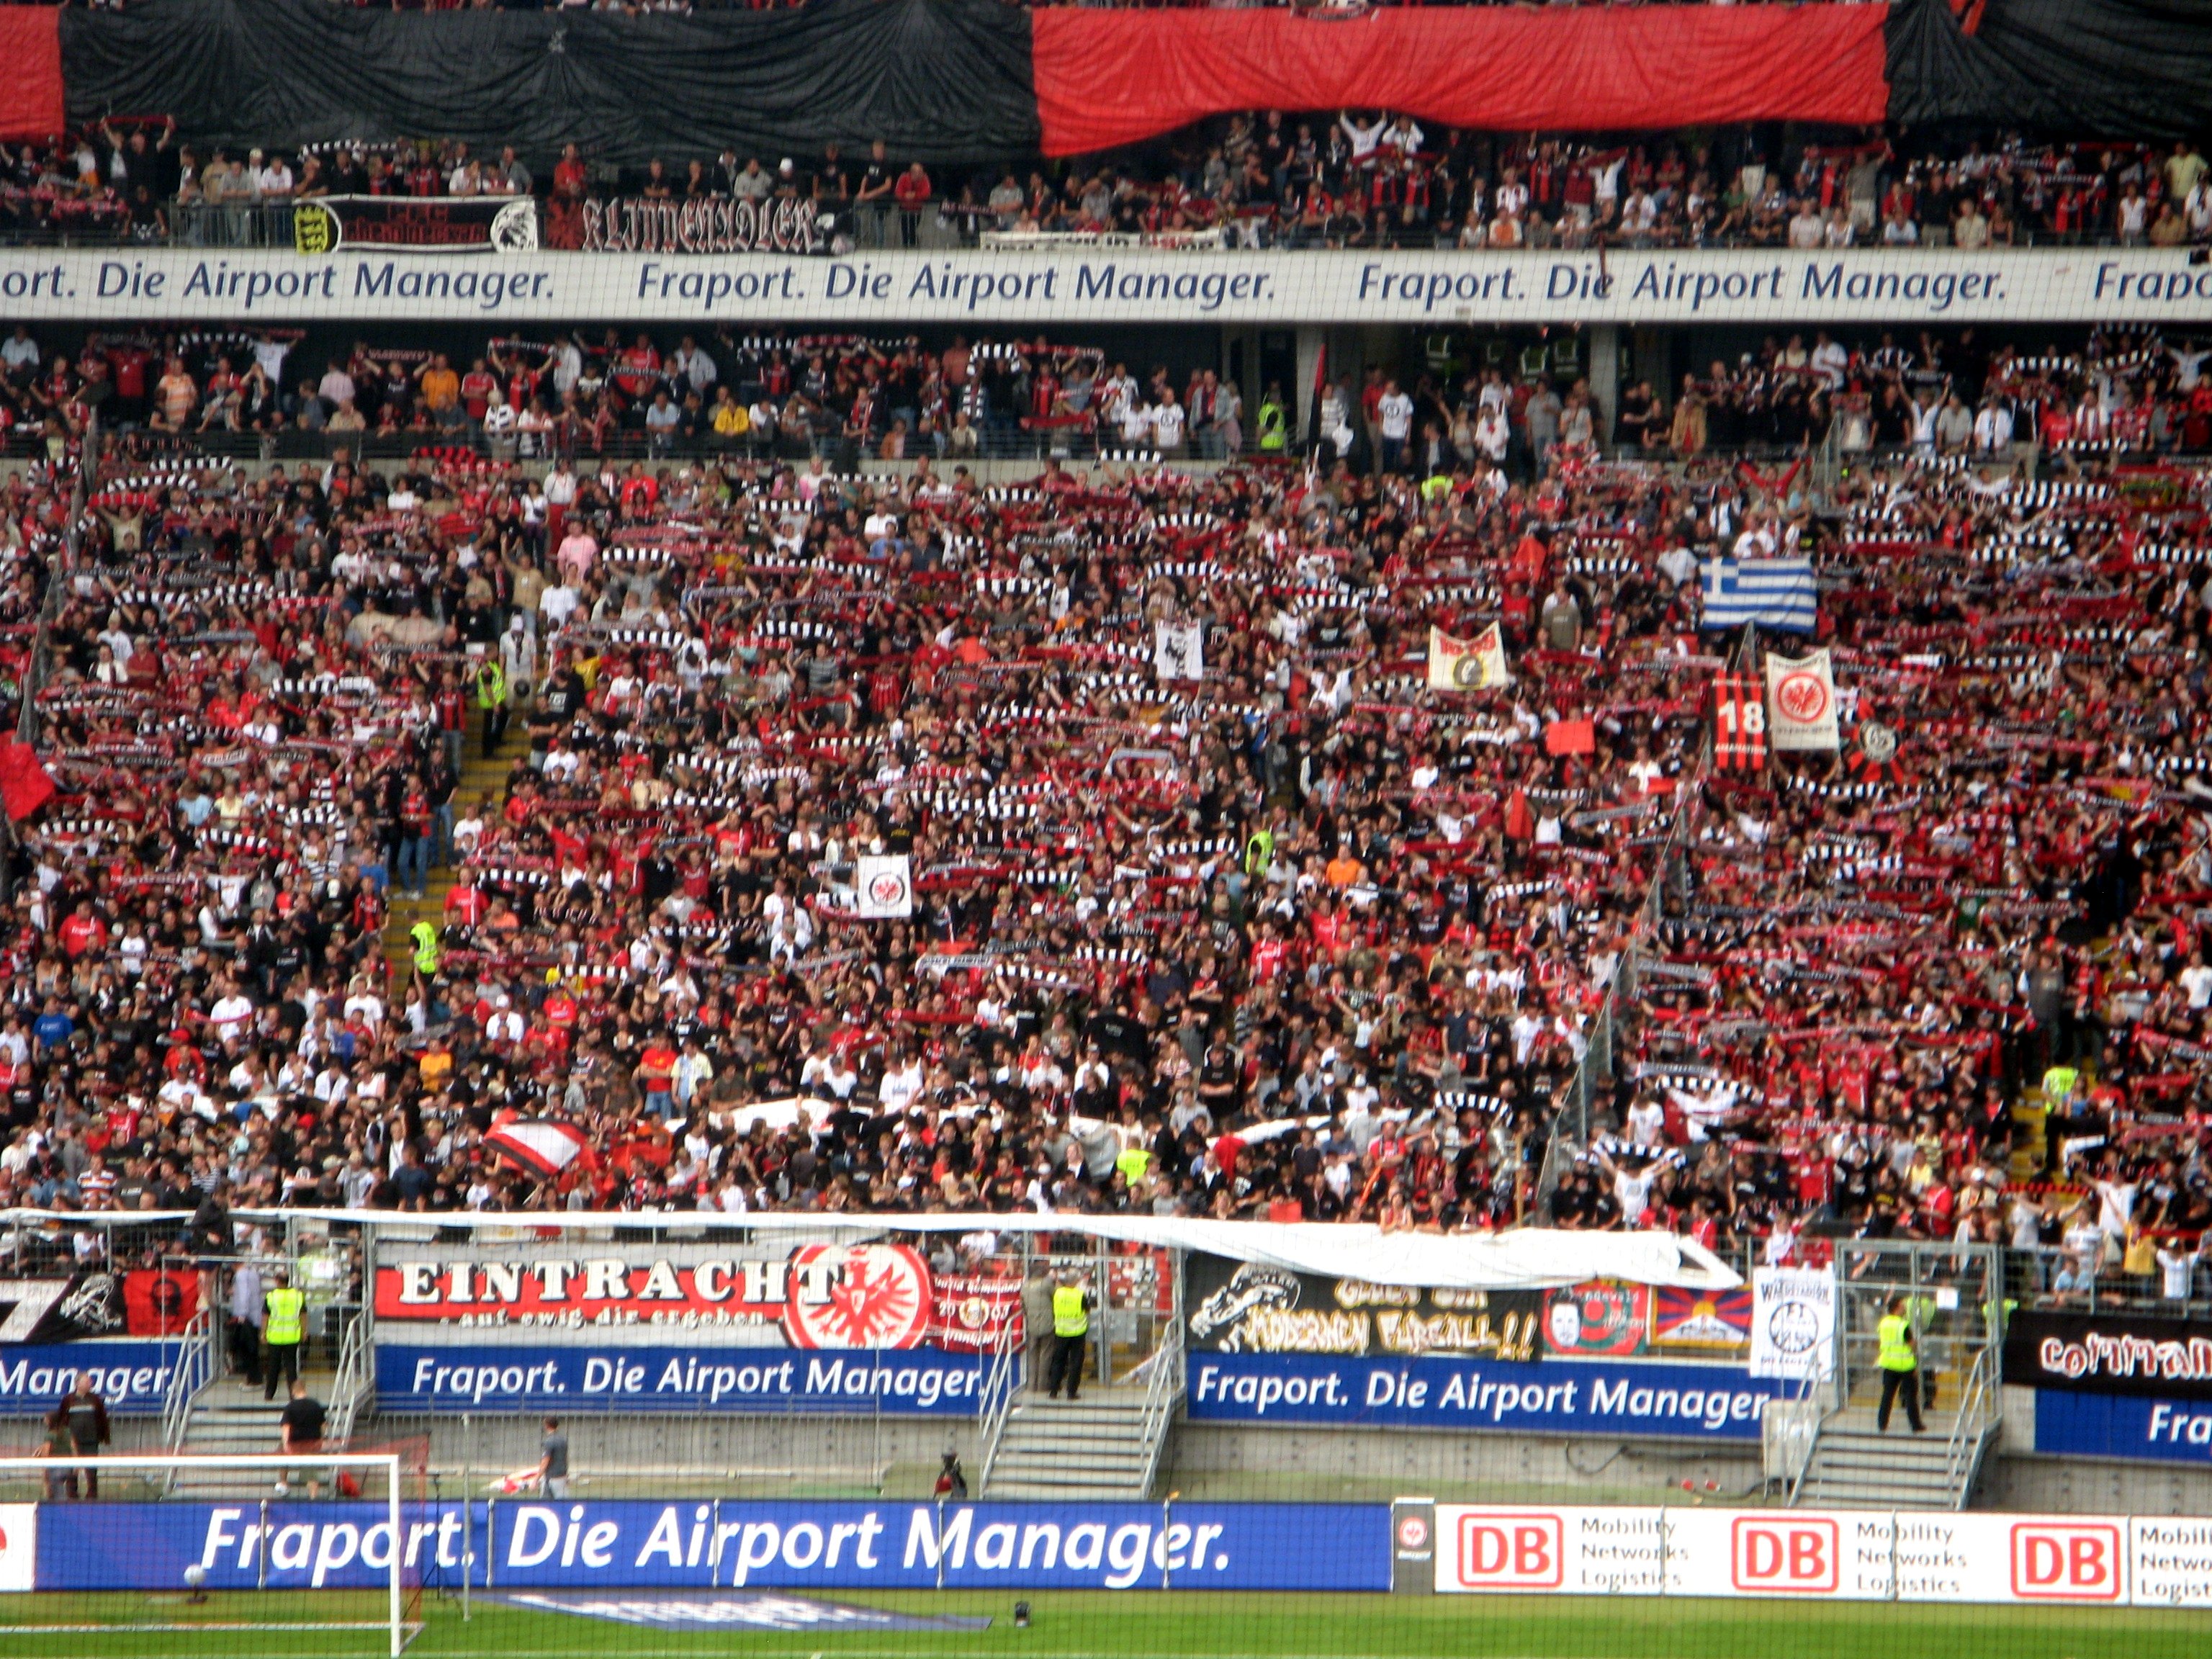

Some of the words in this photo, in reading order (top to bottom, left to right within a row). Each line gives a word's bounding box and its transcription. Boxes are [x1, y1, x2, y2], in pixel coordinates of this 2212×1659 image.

[97, 262, 165, 298] Die
[183, 261, 336, 310] Airport
[354, 263, 553, 310] Manager.
[639, 264, 804, 310] Fraport.
[827, 264, 892, 298] Die
[909, 264, 1055, 310] Airport
[1076, 264, 1273, 311] Manager.
[1359, 264, 1524, 311] Fraport.
[1547, 264, 1614, 299] Die
[1633, 264, 1781, 311] Airport
[1803, 264, 2005, 311] Manager.
[1718, 700, 1765, 734] 18
[398, 1259, 842, 1305] EINTRACHT
[457, 1308, 509, 1329] auf
[520, 1307, 588, 1331] ewig
[595, 1305, 641, 1327] dir
[650, 1308, 768, 1330] ergeben
[413, 1358, 565, 1404] Fraport.
[583, 1357, 644, 1393] Die
[657, 1357, 793, 1403] Airport
[805, 1358, 986, 1407] Manager.
[1197, 1366, 1348, 1414] Fraport.
[1367, 1371, 1427, 1408] Die
[1439, 1373, 1577, 1421] Airport
[2149, 1404, 2212, 1444] Fra
[201, 1507, 475, 1588] Fraport.
[507, 1505, 619, 1568] Die
[635, 1506, 884, 1588] Airport
[903, 1508, 1229, 1589] Manager.
[1472, 1526, 1550, 1575] DB
[1582, 1517, 1676, 1540] Mobility
[1858, 1522, 1954, 1546] Mobility
[1582, 1543, 1689, 1562] Networks
[1746, 1529, 1825, 1579] DB
[1858, 1548, 1966, 1568] Networks
[2025, 1536, 2107, 1586] DB
[1582, 1569, 1681, 1593] Logistics
[1858, 1575, 1960, 1597] Logistics
